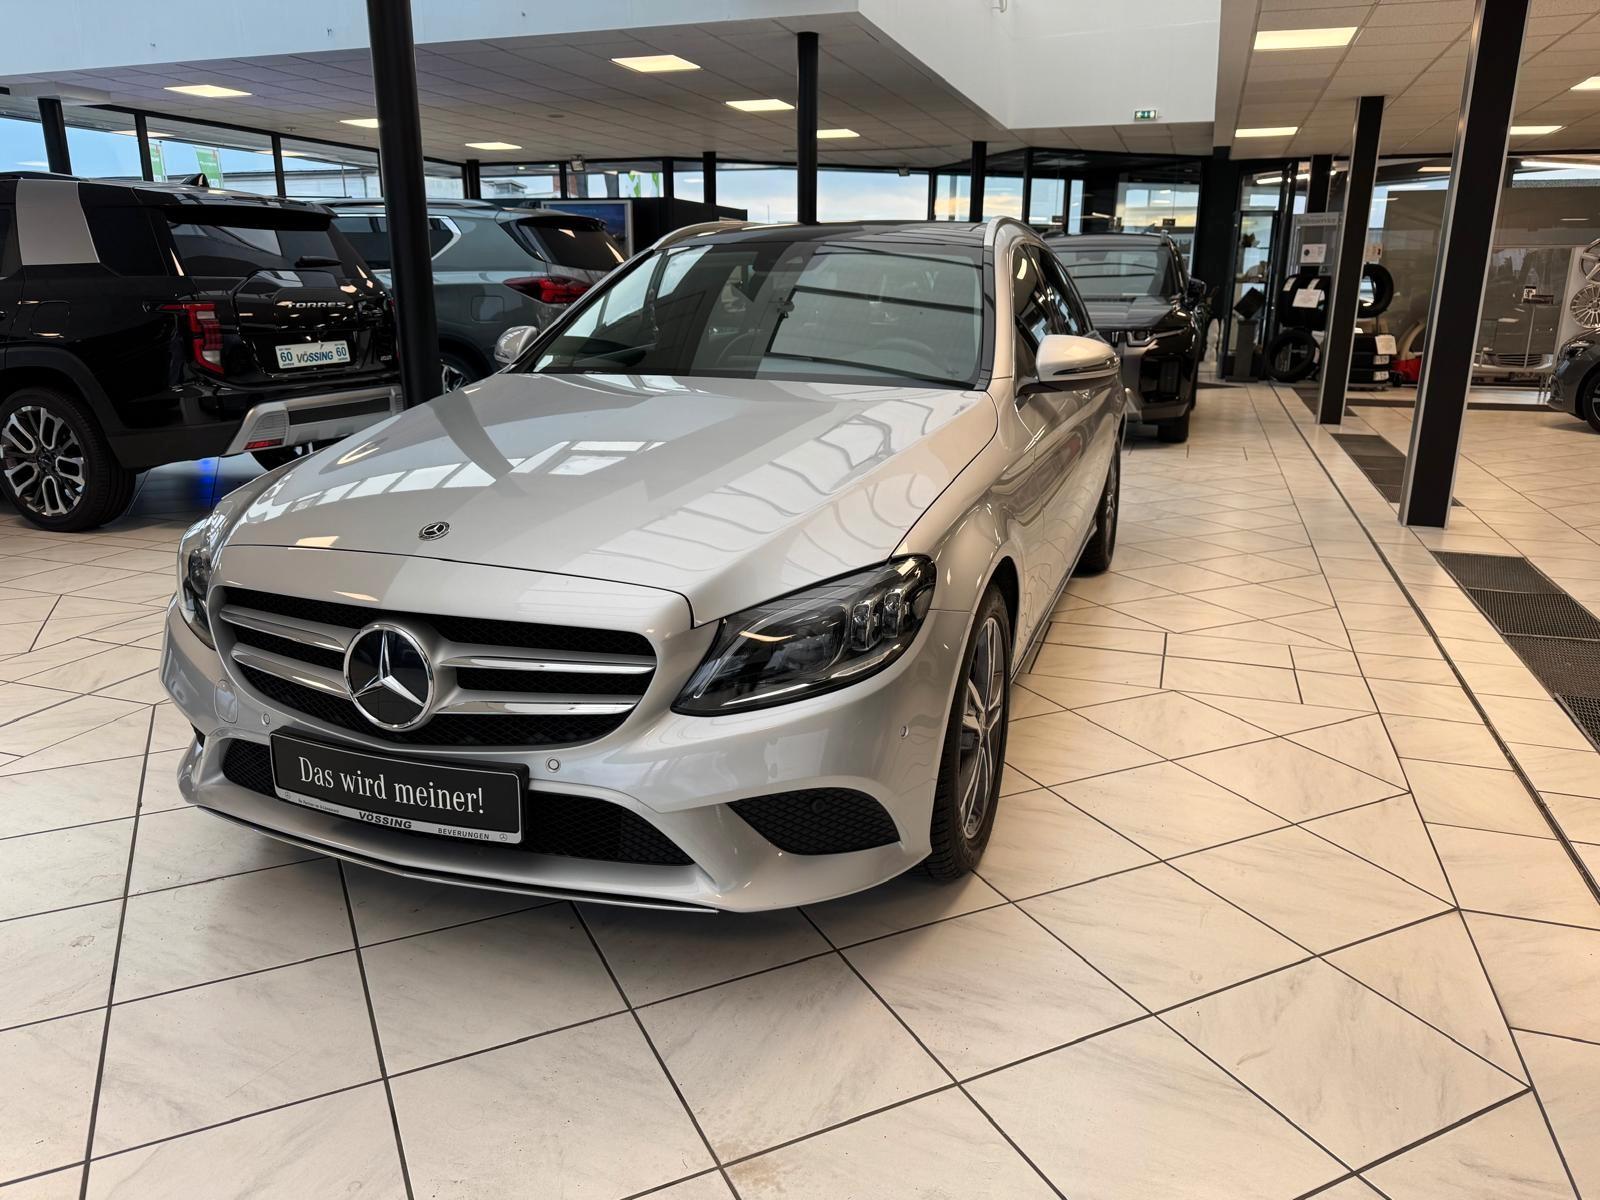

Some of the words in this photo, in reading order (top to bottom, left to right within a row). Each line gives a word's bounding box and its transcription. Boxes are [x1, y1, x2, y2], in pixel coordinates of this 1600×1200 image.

[280, 352, 293, 362] 60
[336, 347, 347, 356] 60
[299, 757, 334, 788] Das
[339, 770, 387, 799] wird
[393, 782, 484, 814] meiner!
[358, 811, 412, 829] VÖSSING
[437, 827, 490, 840] BEVERUNGEN
